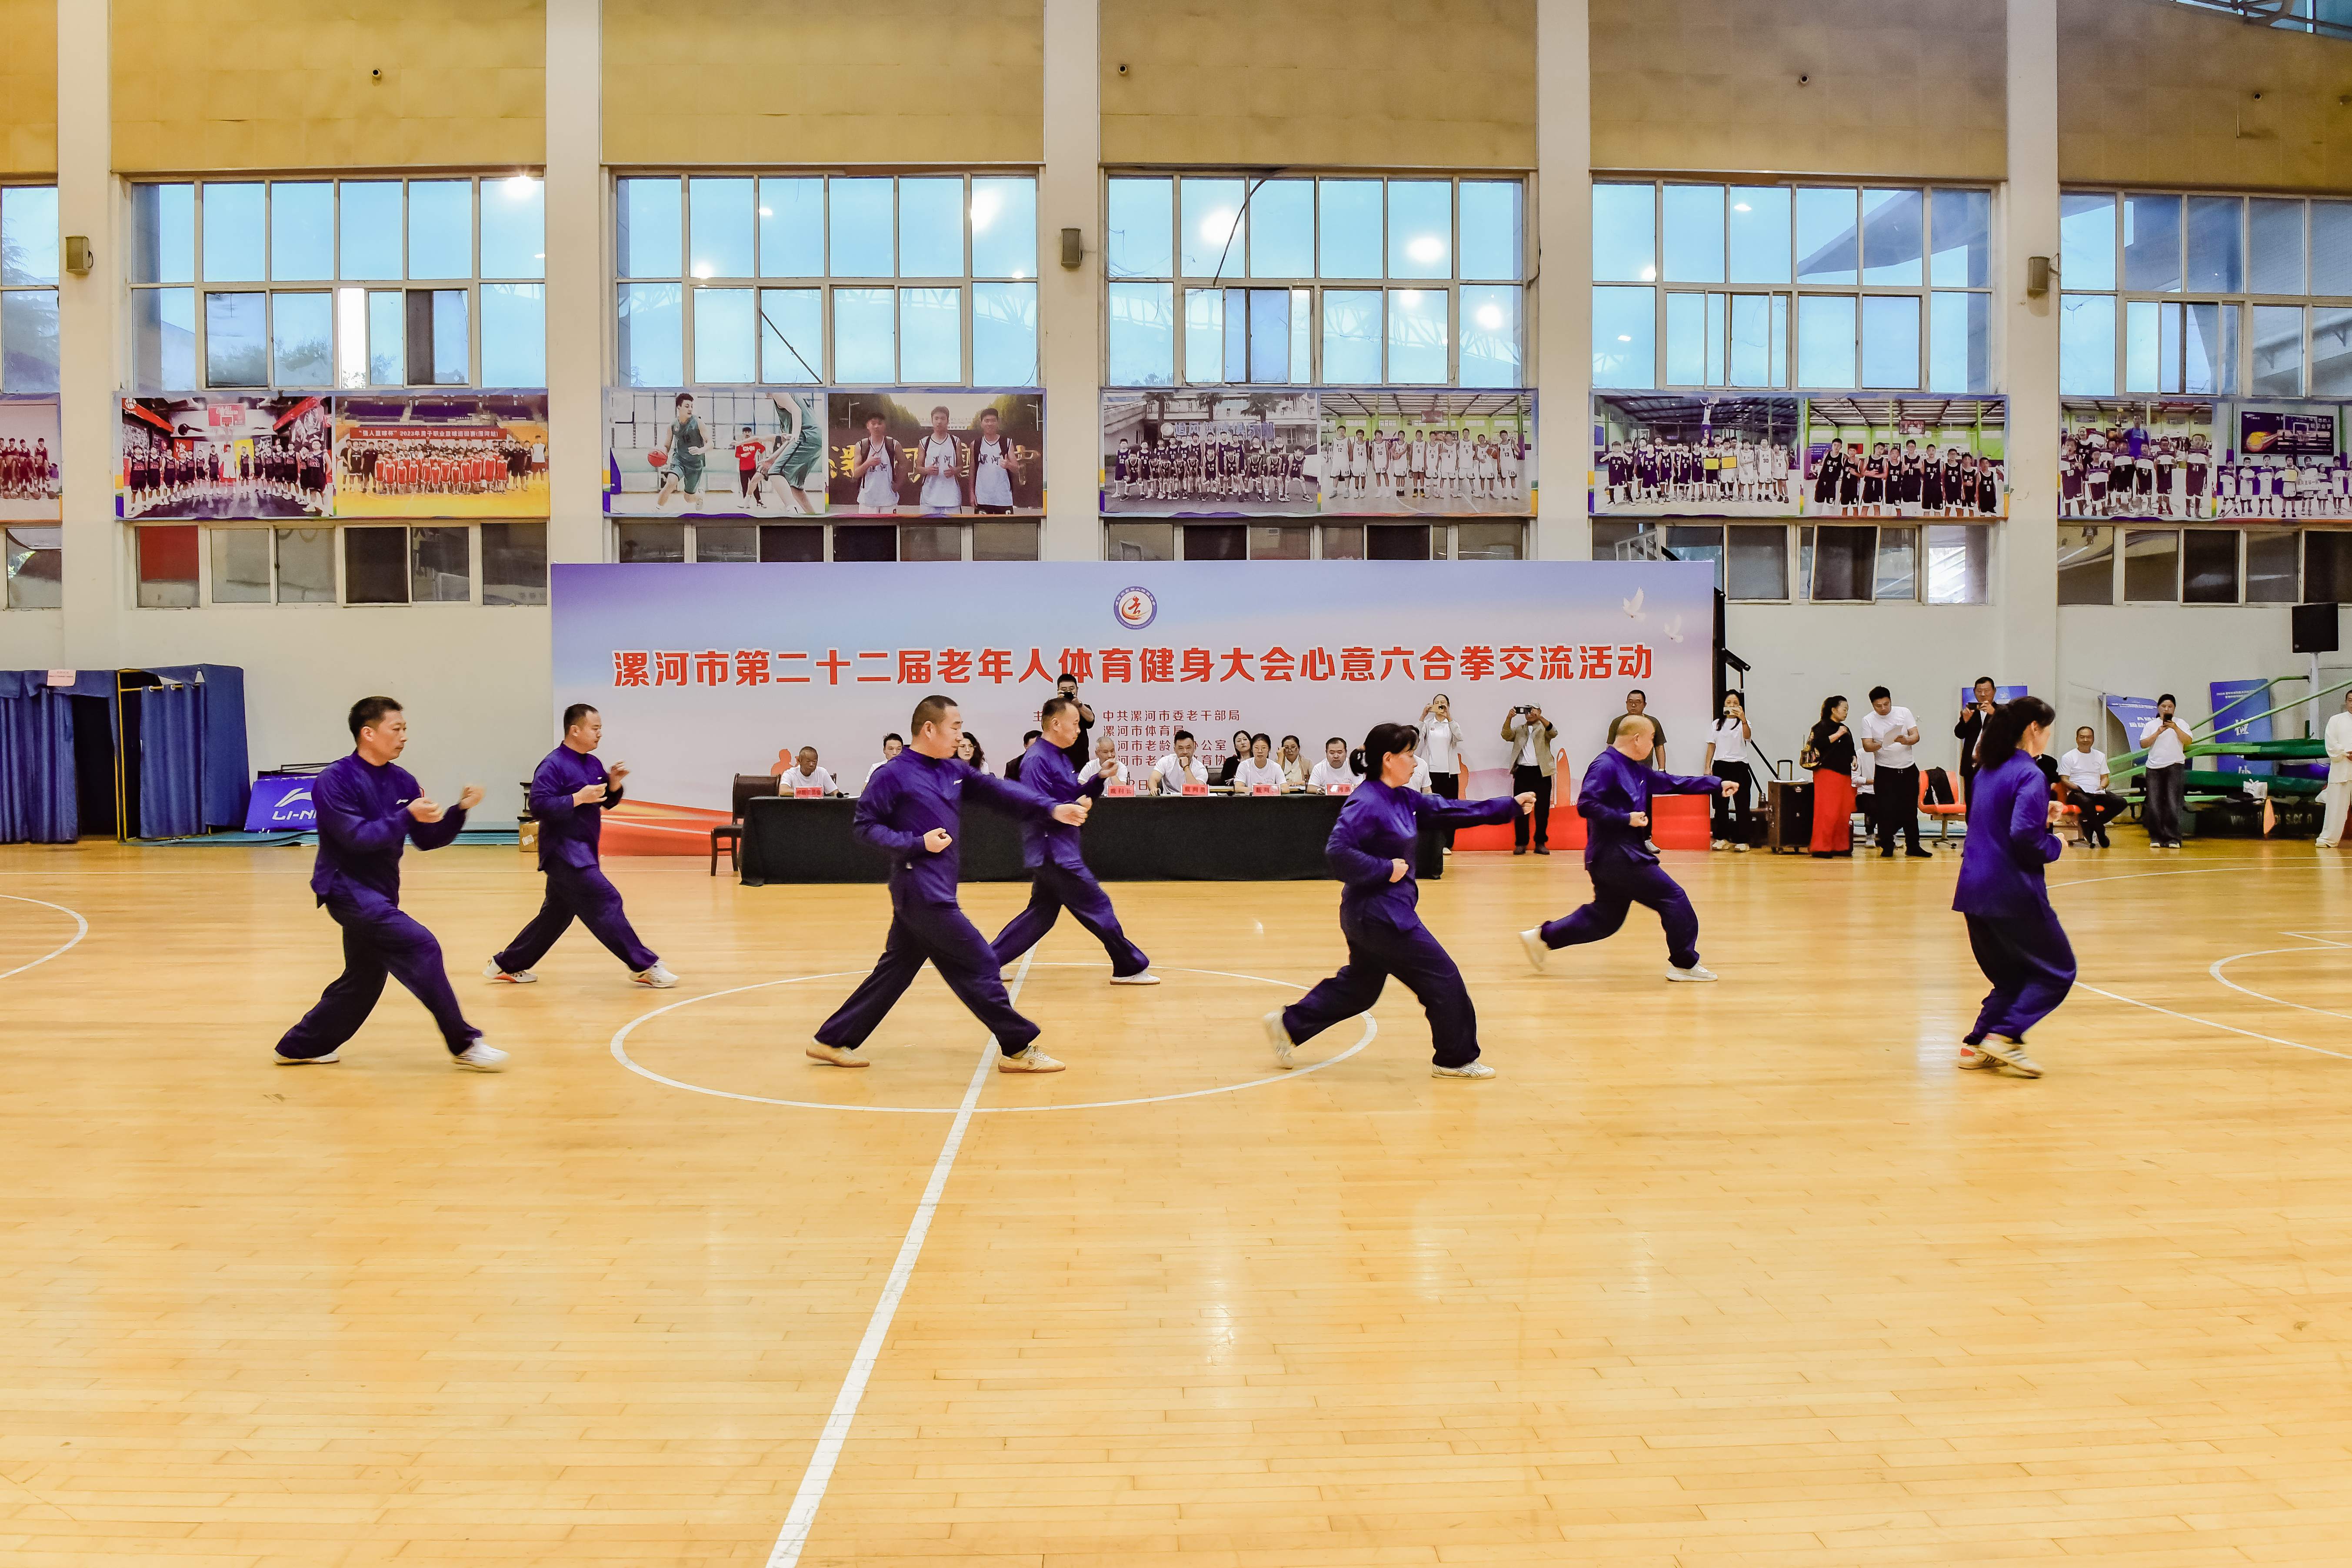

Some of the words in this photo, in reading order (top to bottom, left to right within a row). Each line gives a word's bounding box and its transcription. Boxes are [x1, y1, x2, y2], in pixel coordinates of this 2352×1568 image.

[613, 644, 1653, 686] 漯河市第二十二届老年人体育健身大会心意六合拳交流活动
[1103, 710, 1240, 722] 中共漯河市委老干部局
